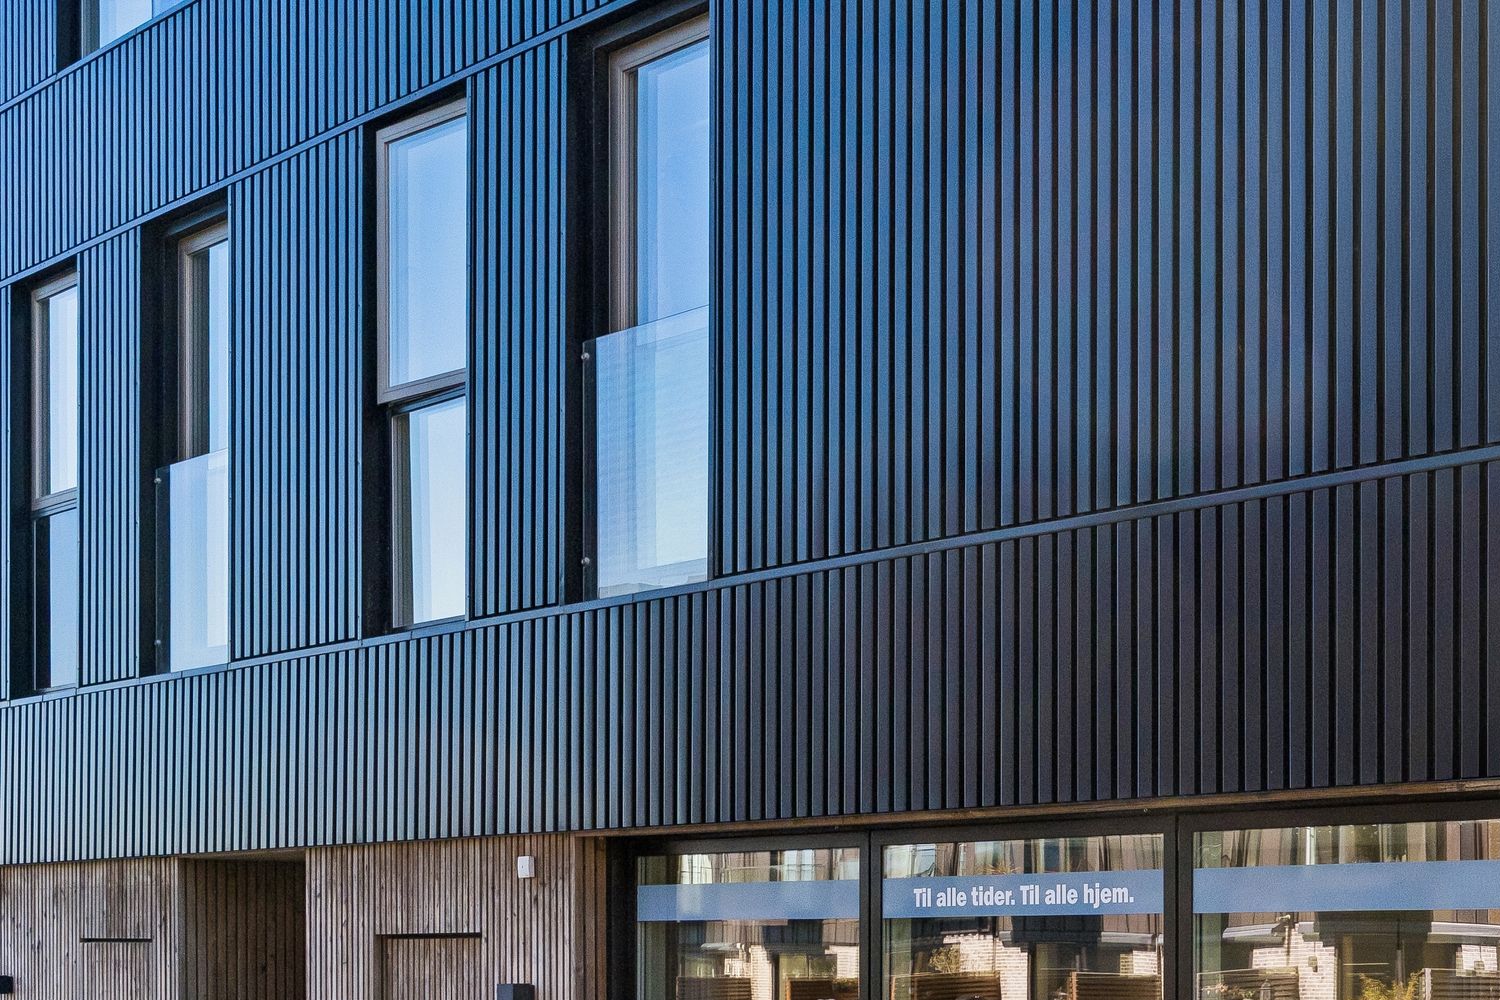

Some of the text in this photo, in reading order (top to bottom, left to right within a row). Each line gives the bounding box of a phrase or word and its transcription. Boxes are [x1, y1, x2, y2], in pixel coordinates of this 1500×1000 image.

[913, 882, 1135, 909] Til alle tider. Til alle hjem.
